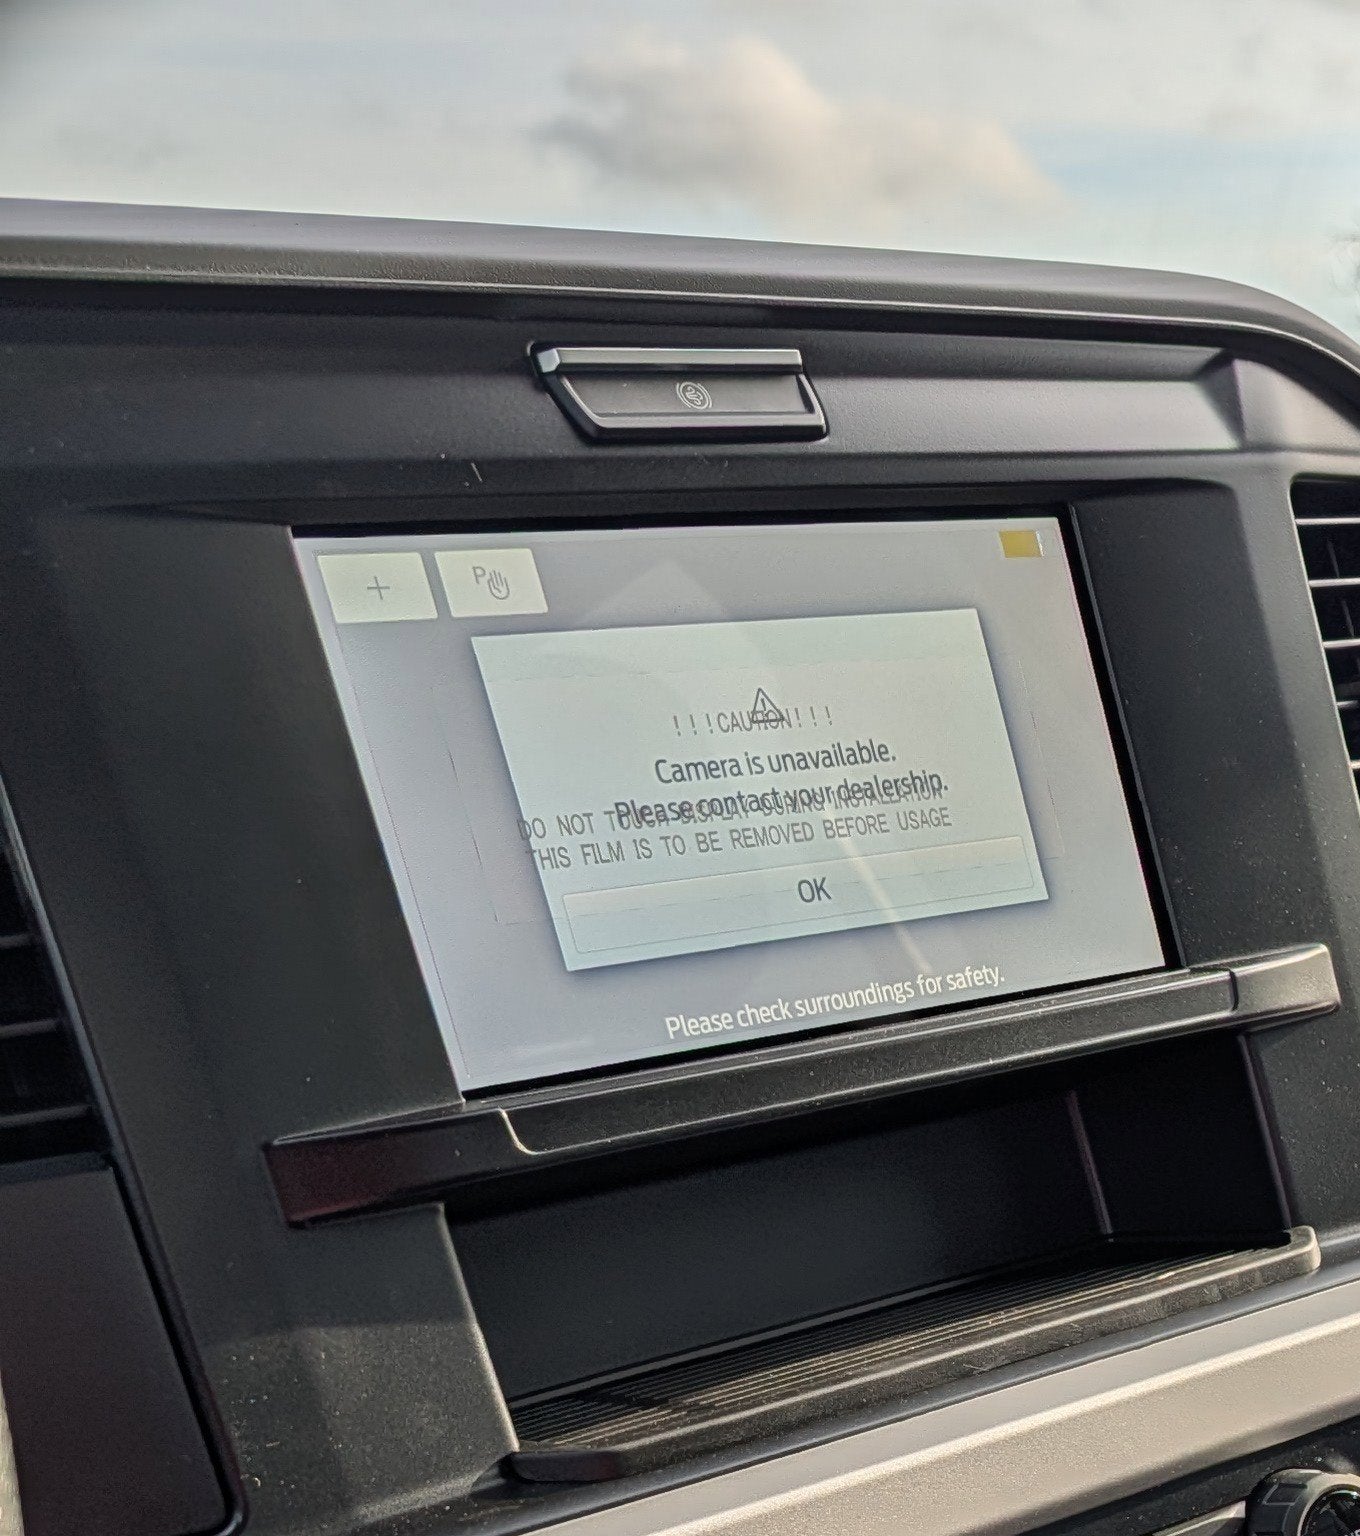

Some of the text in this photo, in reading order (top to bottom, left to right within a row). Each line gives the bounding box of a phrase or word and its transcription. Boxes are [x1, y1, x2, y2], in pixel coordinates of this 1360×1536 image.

[654, 738, 897, 784] Camera is unavailable.
[614, 769, 949, 829] Please contact your dealership.
[517, 817, 547, 841] DO
[556, 812, 595, 837] NOT
[525, 807, 953, 871] THIS FILM IS TO BE REMOVED BEFORE USAGE
[797, 876, 832, 904] OK
[665, 964, 1006, 1040] Please check surroundings for safety.
